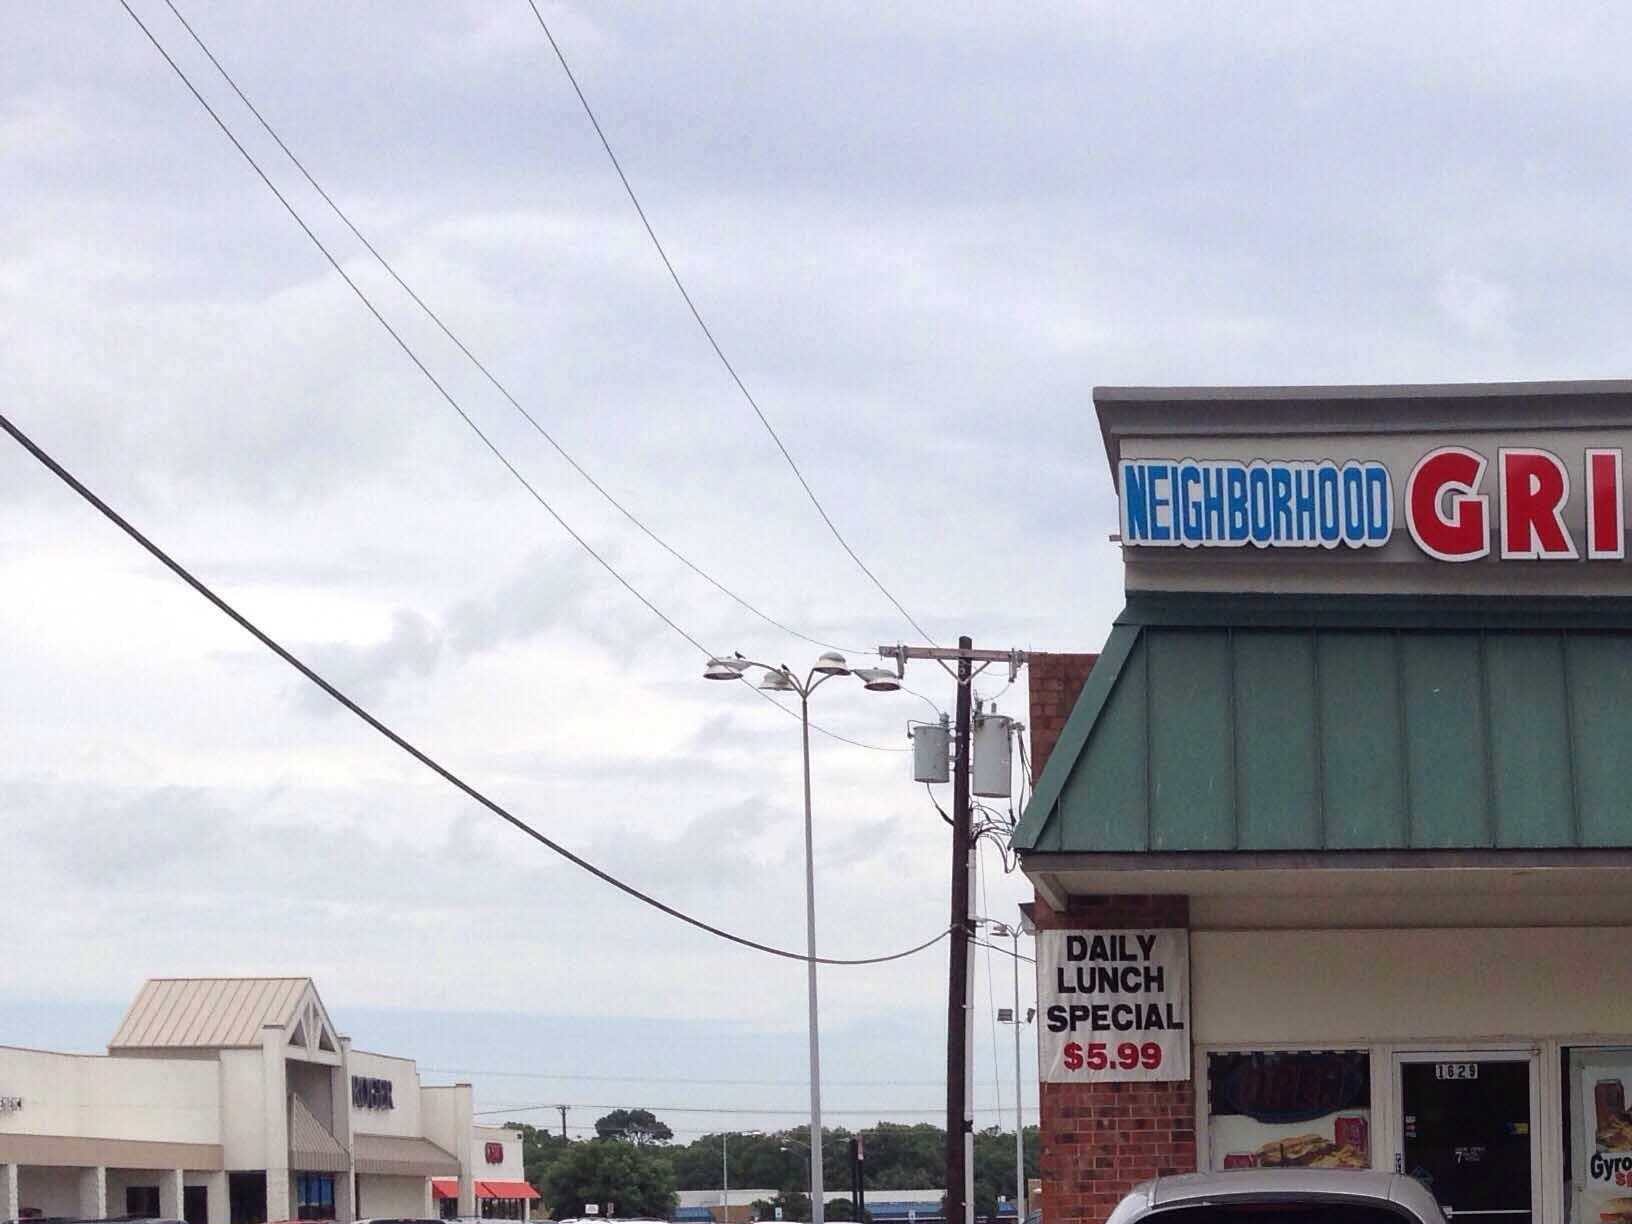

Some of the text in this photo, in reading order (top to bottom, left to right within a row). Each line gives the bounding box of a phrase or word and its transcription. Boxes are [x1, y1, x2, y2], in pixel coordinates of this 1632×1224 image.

[1120, 459, 1393, 549] NEIGHBORHOOD
[1066, 935, 1157, 962] DAILY
[1057, 966, 1164, 993] LUNCH
[1047, 1003, 1184, 1032] SPECIAL
[1063, 1041, 1162, 1071] $5.99
[1437, 1064, 1478, 1079] 1629
[1591, 1152, 1632, 1181] Gyro
